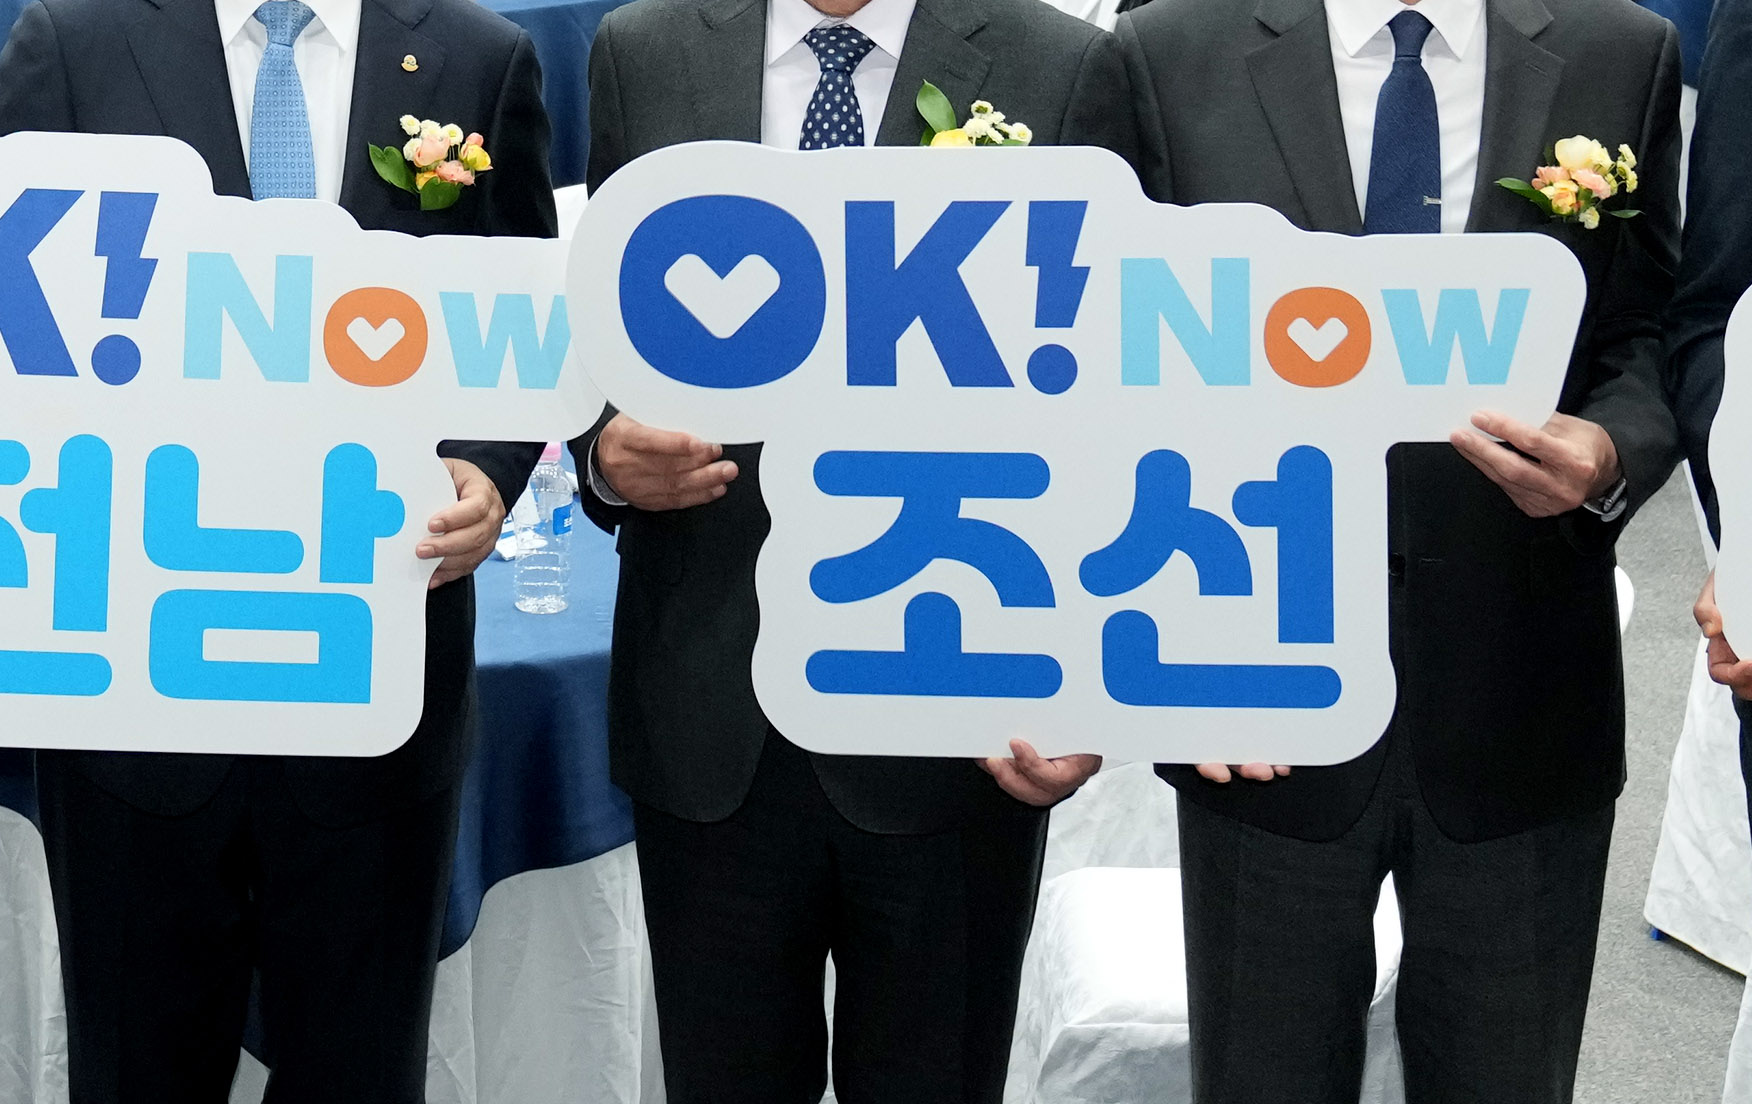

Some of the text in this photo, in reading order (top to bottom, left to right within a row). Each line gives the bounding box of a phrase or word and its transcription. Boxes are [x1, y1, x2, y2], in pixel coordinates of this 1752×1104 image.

[183, 252, 570, 390] Now
[618, 194, 1530, 394] OK! Now
[805, 444, 1342, 708] 조선
